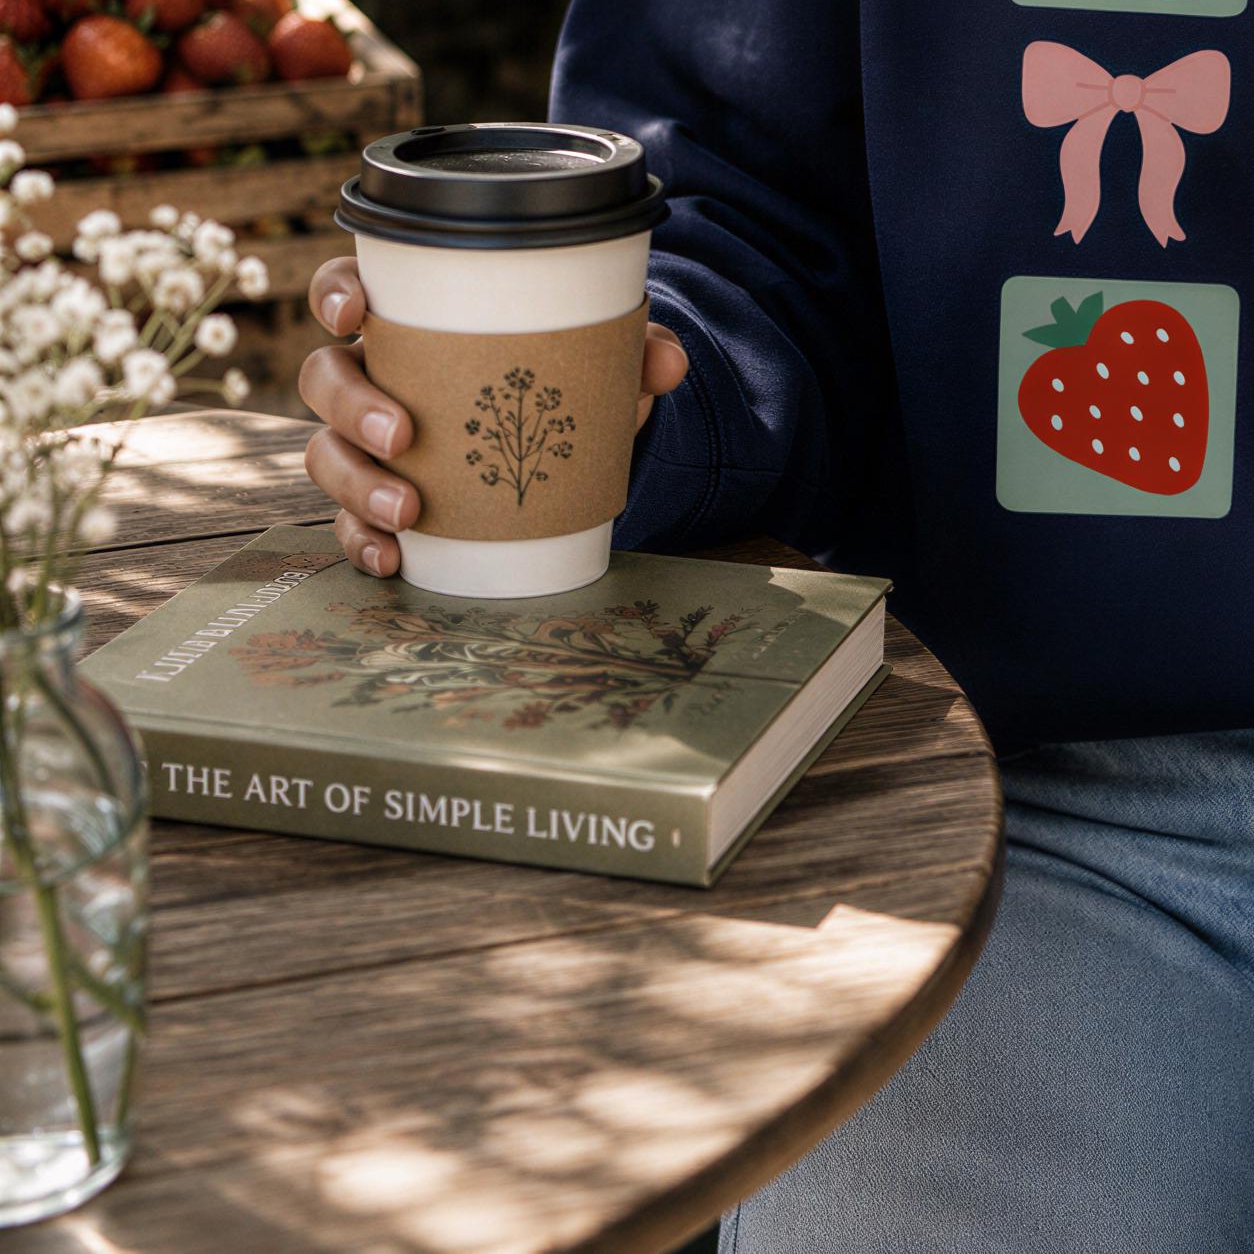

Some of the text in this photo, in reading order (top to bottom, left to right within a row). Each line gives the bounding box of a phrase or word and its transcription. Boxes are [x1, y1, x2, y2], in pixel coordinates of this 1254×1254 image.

[161, 762, 233, 799] THE
[243, 773, 313, 809] ART
[324, 782, 372, 815] OF
[384, 789, 514, 834] SIMPLE
[527, 806, 655, 852] LIVING
